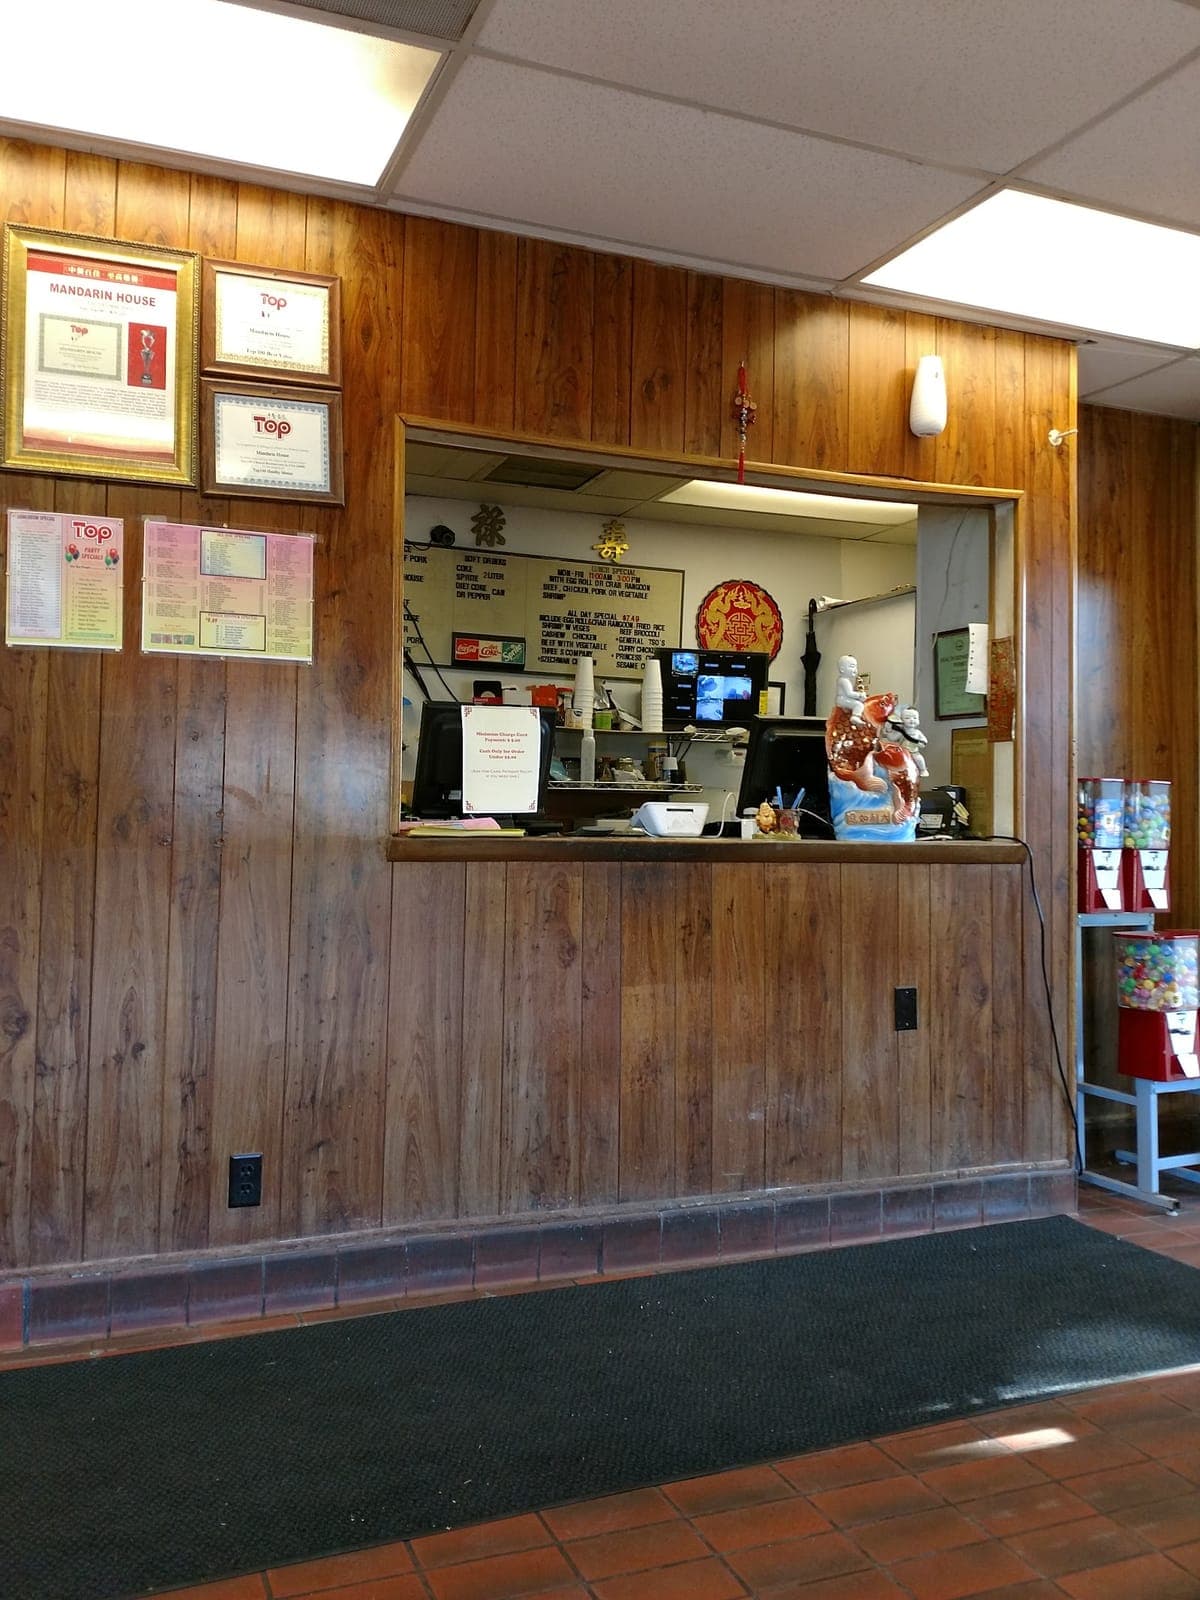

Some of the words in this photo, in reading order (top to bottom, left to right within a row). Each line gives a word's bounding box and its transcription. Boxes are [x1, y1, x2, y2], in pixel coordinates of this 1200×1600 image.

[50, 283, 112, 301] MANDARIN
[116, 292, 156, 307] HOUSE
[261, 293, 287, 310] Top
[253, 415, 291, 439] Top
[72, 521, 113, 544] Top
[464, 555, 481, 564] SOFT
[482, 557, 507, 567] DRINKS
[456, 564, 473, 573] COKE
[612, 568, 636, 577] SPECIAL
[456, 573, 479, 583] SPRITE
[549, 575, 565, 583] WITH
[566, 577, 578, 585] EGG
[578, 578, 593, 586] ROLL
[594, 579, 604, 587] OR
[605, 581, 622, 589] CRAB
[624, 583, 651, 592] RANGOON
[455, 582, 470, 590] DIET
[471, 584, 487, 592] COKE
[491, 588, 506, 597] CAN
[456, 590, 466, 599] DR
[467, 592, 491, 601] PEPPER
[542, 592, 566, 601] SHRIMP
[591, 588, 608, 596] PORK
[608, 589, 618, 597] OR
[618, 590, 649, 600] VEGETABLE
[567, 609, 577, 617] ALL
[580, 611, 592, 619] DAY
[594, 612, 617, 621] SPECIAL
[541, 621, 564, 630] SHRIMP
[636, 622, 651, 631] FRIED
[653, 624, 666, 632] RICE
[541, 630, 566, 639] CASHEW
[572, 632, 597, 641] CHICKEN
[620, 628, 632, 636] BEEF
[633, 629, 660, 638] BROCCOLI
[541, 638, 555, 647] BEEF
[557, 640, 574, 648] WITH
[575, 641, 608, 651] VEGETABLE
[618, 644, 635, 653] CURRY
[502, 643, 522, 662] Sprite
[615, 661, 638, 670] SESAME
